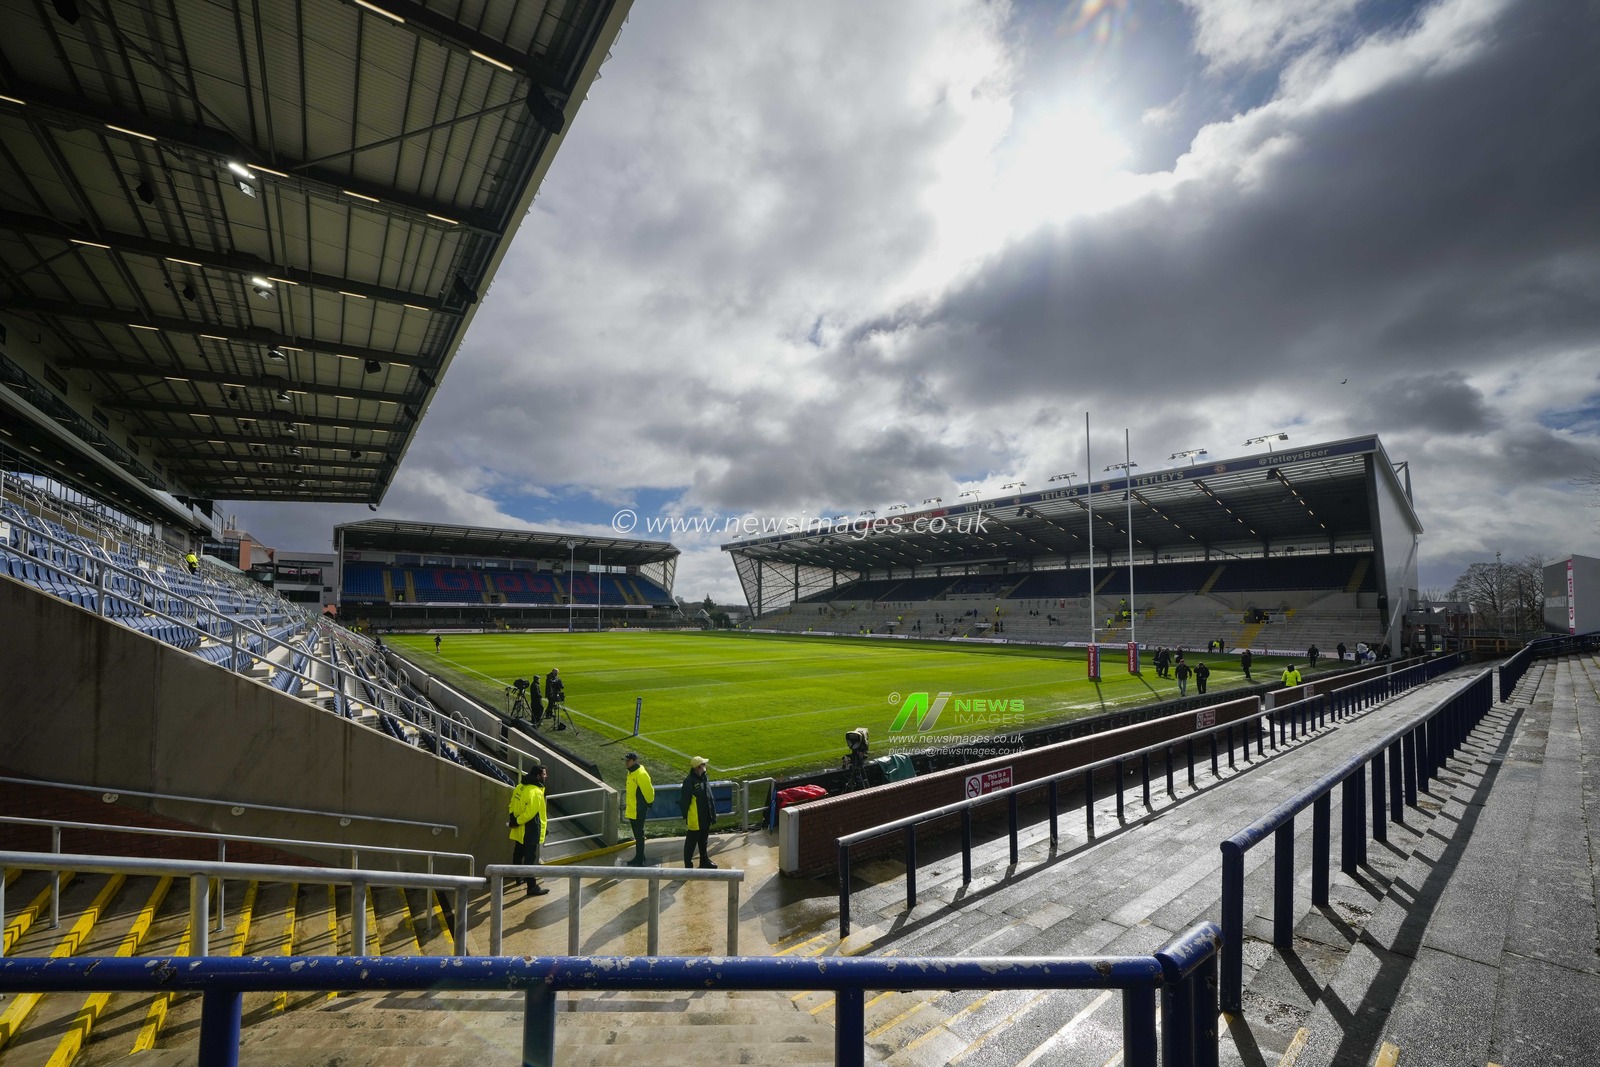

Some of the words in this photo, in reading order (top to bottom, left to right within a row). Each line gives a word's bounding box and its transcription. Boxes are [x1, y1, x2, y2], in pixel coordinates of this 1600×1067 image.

[1258, 449, 1329, 465] @TetleysBeer
[1135, 472, 1184, 486] TETLEY'S
[1040, 489, 1078, 501] TETLEY'S
